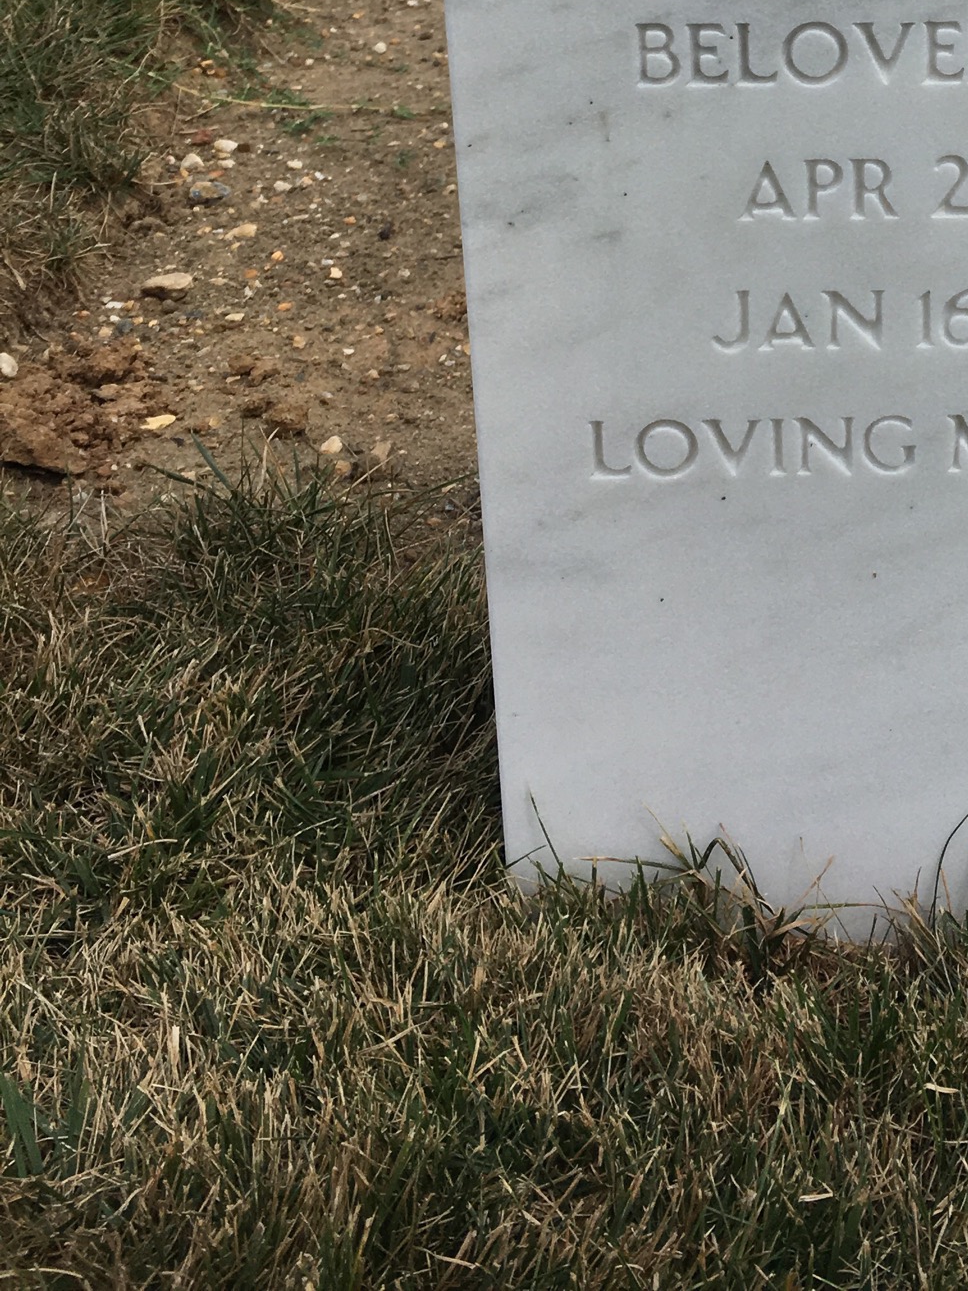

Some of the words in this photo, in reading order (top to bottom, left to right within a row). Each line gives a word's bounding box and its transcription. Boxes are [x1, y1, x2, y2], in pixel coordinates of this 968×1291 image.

[737, 158, 899, 222] APR
[711, 288, 886, 353] JAN
[589, 415, 917, 479] LOVING
